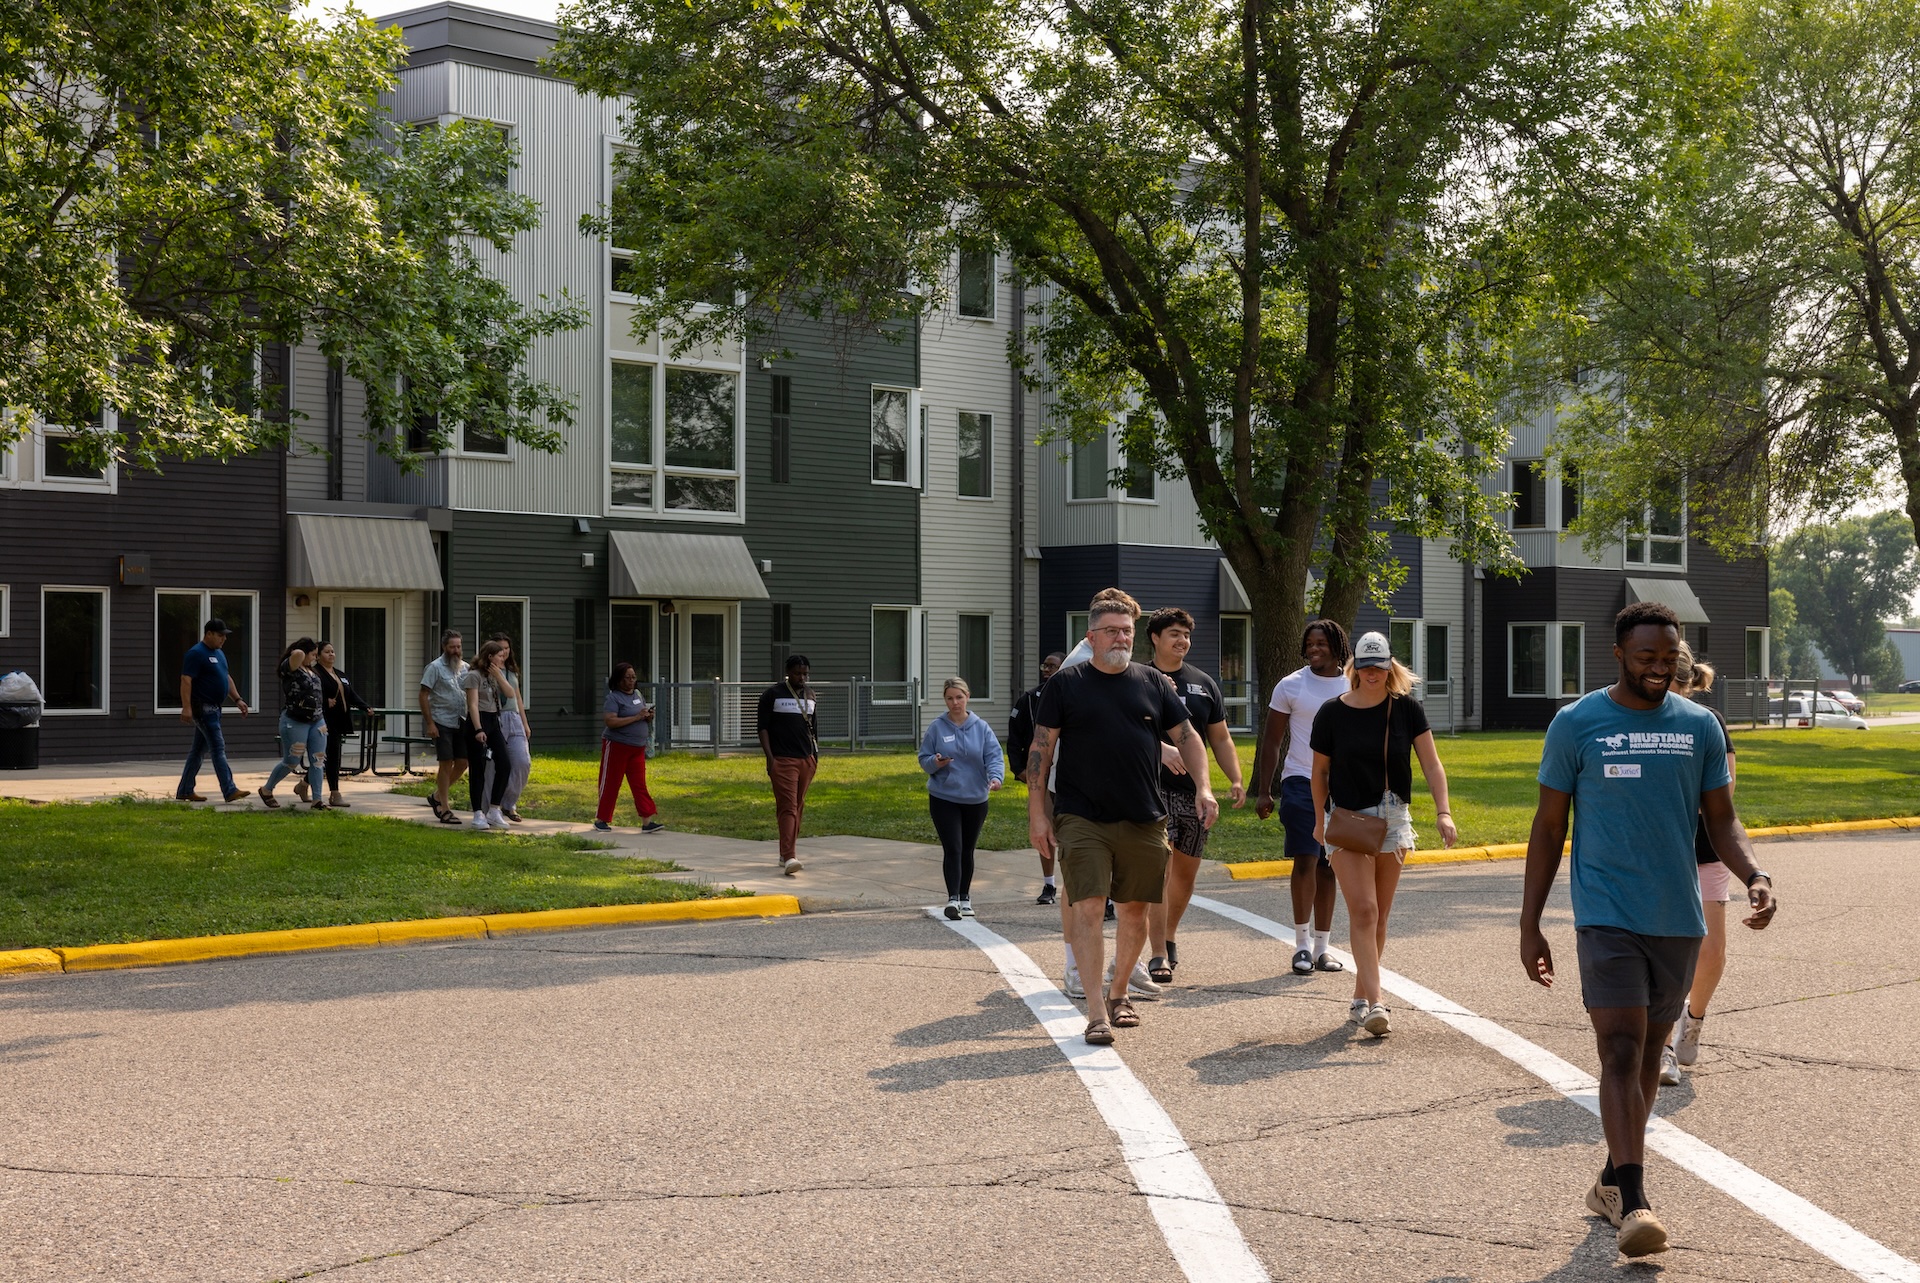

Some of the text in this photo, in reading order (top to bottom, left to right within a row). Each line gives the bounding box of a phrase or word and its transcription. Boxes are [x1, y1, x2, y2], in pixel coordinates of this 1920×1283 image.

[1628, 733, 1694, 744] MUSTANG
[1670, 749, 1694, 757] University
[1619, 766, 1640, 776] Junior
